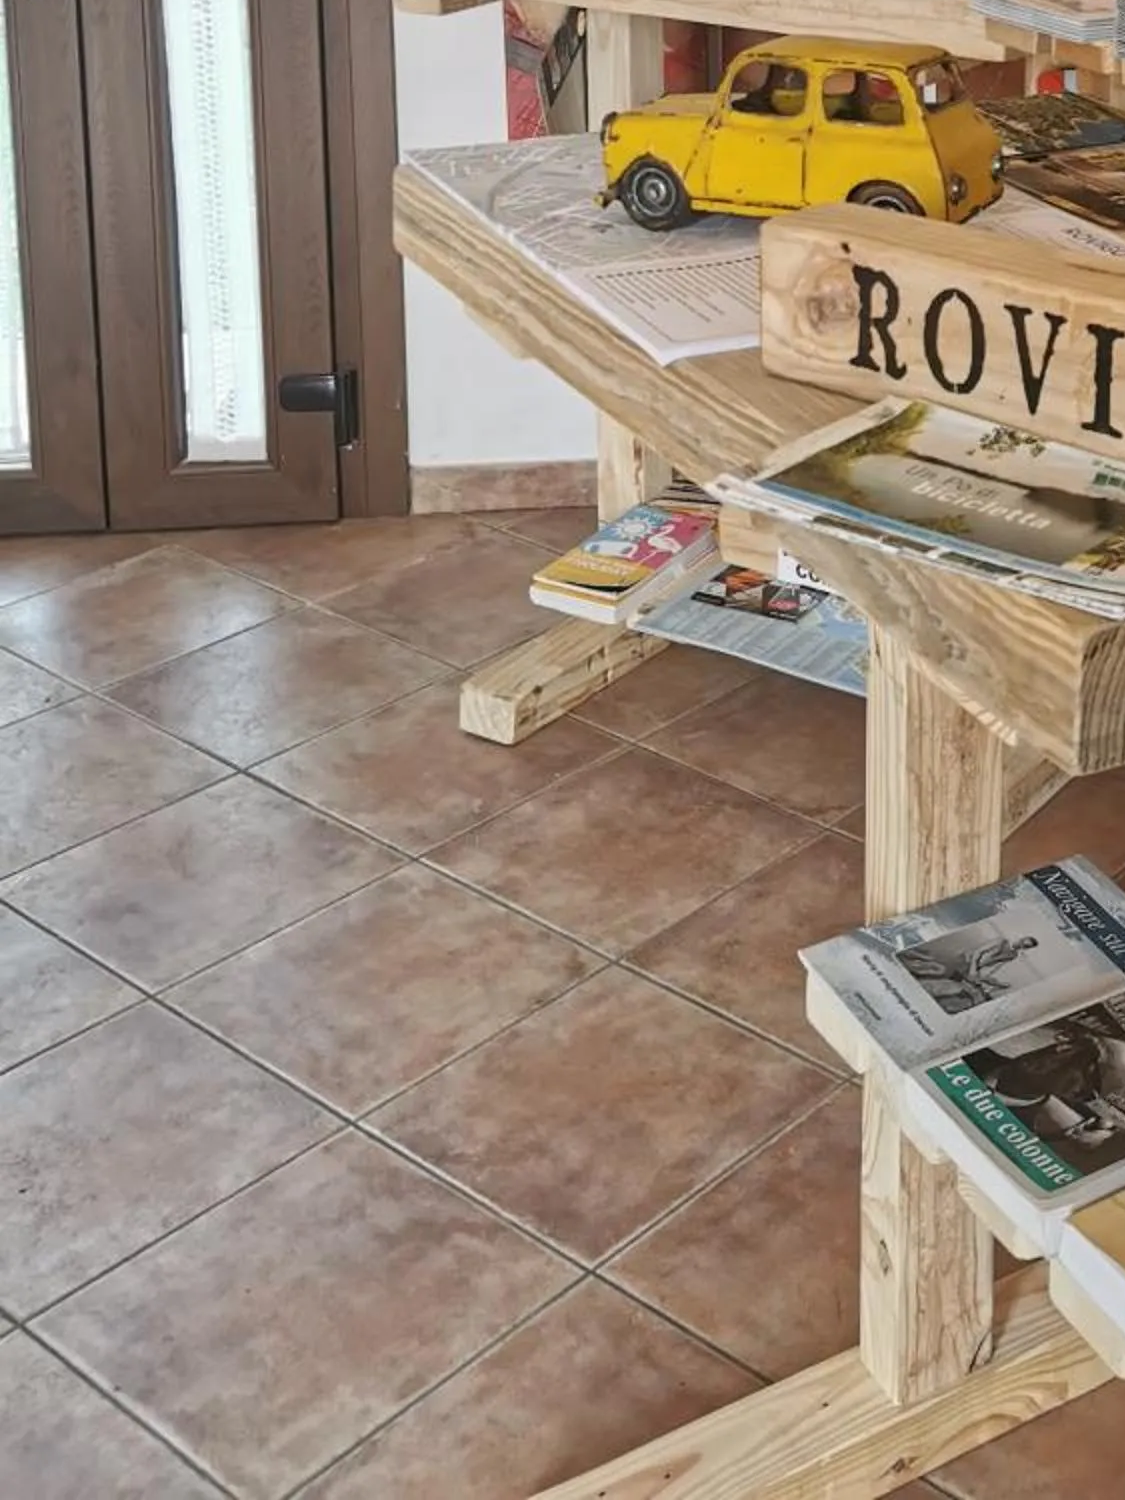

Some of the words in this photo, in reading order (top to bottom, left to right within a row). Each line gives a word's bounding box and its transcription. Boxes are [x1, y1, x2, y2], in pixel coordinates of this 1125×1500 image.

[911, 480, 1054, 531] bicicletta
[939, 1058, 972, 1088] Le
[963, 1088, 1005, 1122] due
[996, 1122, 1075, 1186] colonne
